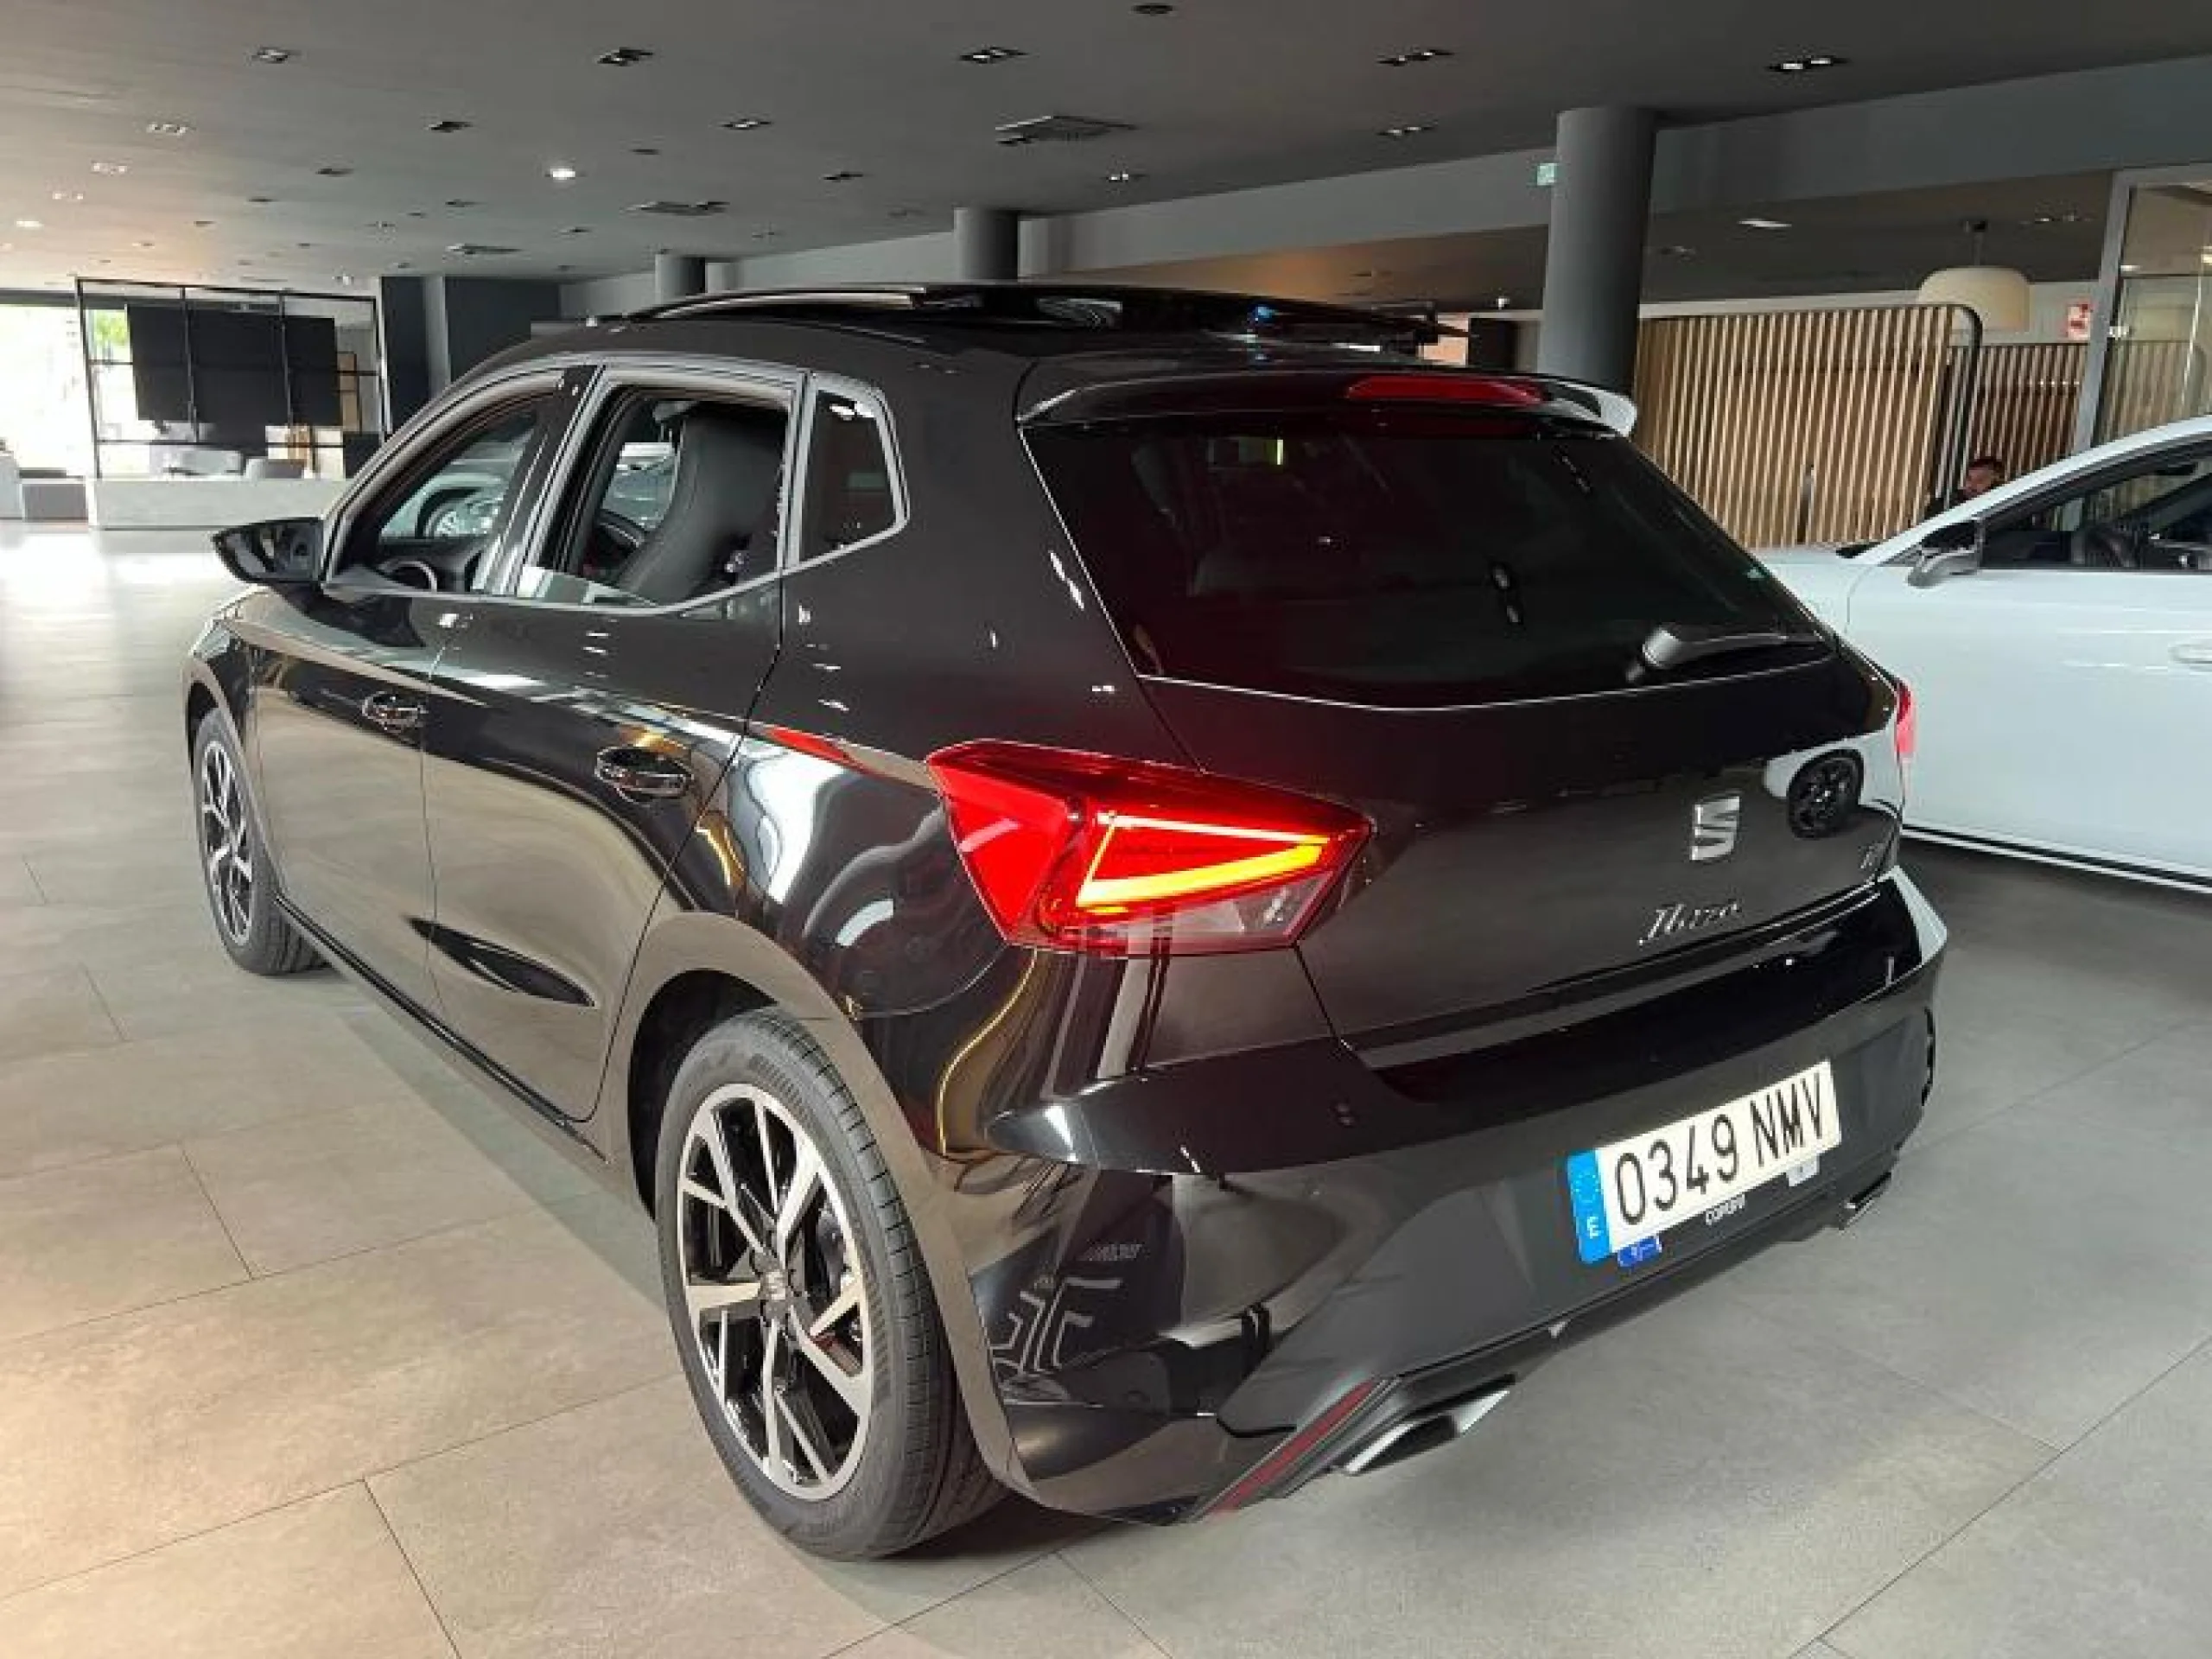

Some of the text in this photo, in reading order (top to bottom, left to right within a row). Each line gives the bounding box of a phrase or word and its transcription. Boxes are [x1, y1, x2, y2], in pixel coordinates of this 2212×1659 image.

[1614, 1072, 1824, 1225] 0349 NMV
[1586, 1216, 1604, 1239] E
